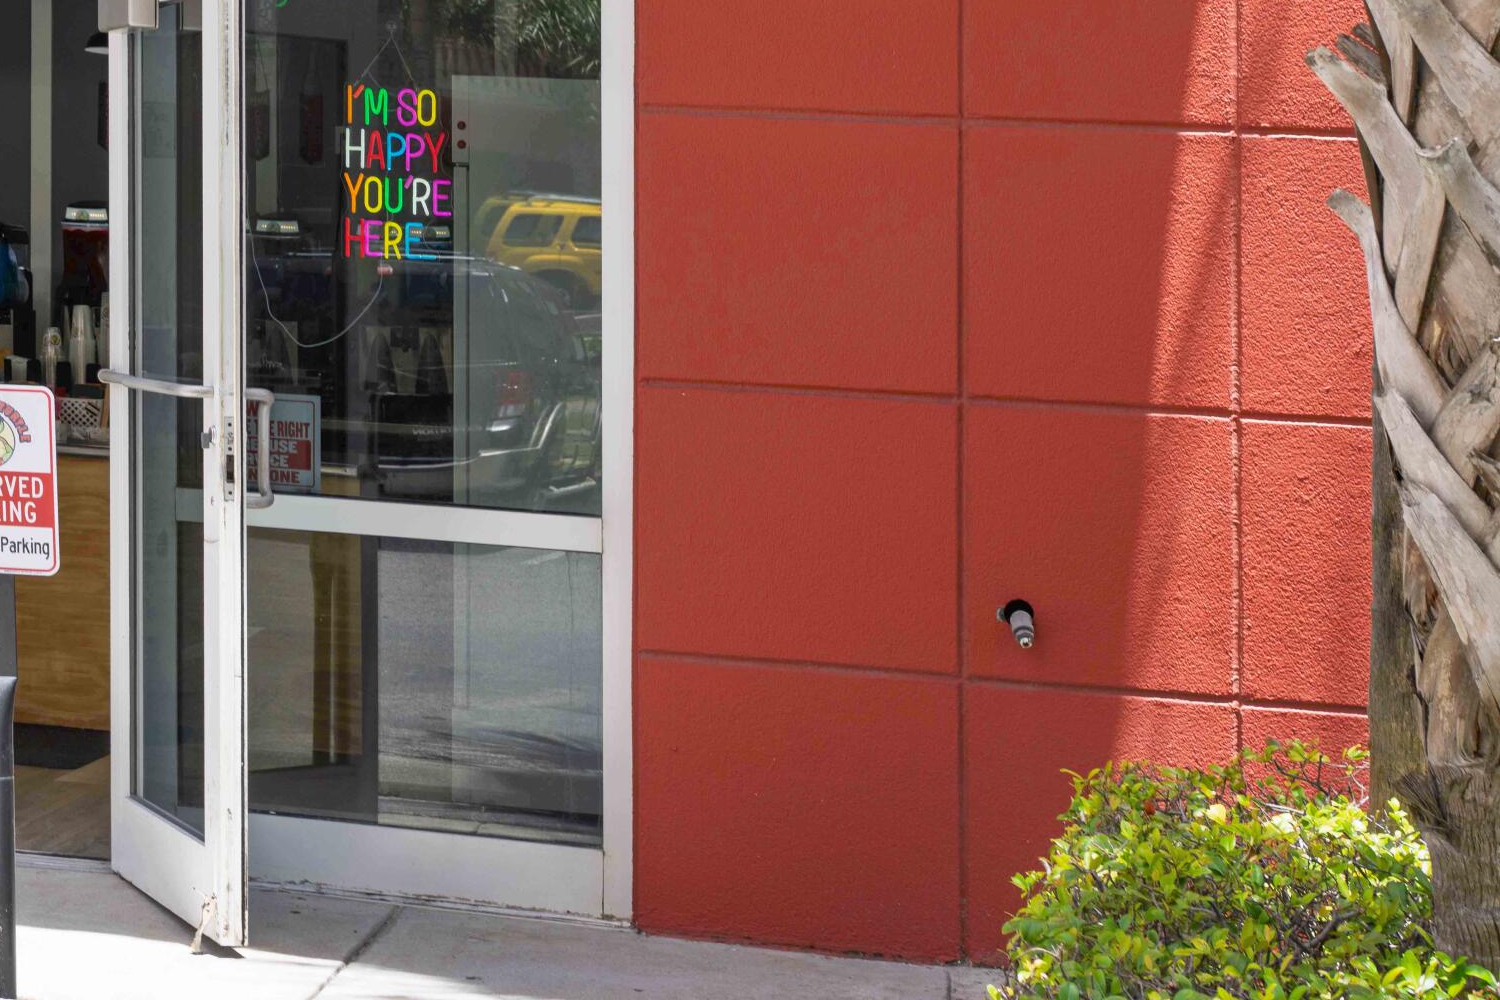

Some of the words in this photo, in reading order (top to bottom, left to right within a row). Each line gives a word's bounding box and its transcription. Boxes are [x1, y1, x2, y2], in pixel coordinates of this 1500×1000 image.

[346, 83, 389, 127] I'M
[396, 87, 437, 127] SO
[344, 127, 446, 174] HAPPY
[343, 171, 452, 217] YOU'RE
[344, 216, 437, 261] HERE
[277, 420, 311, 439] RIGHT
[0, 536, 50, 560] Parking
